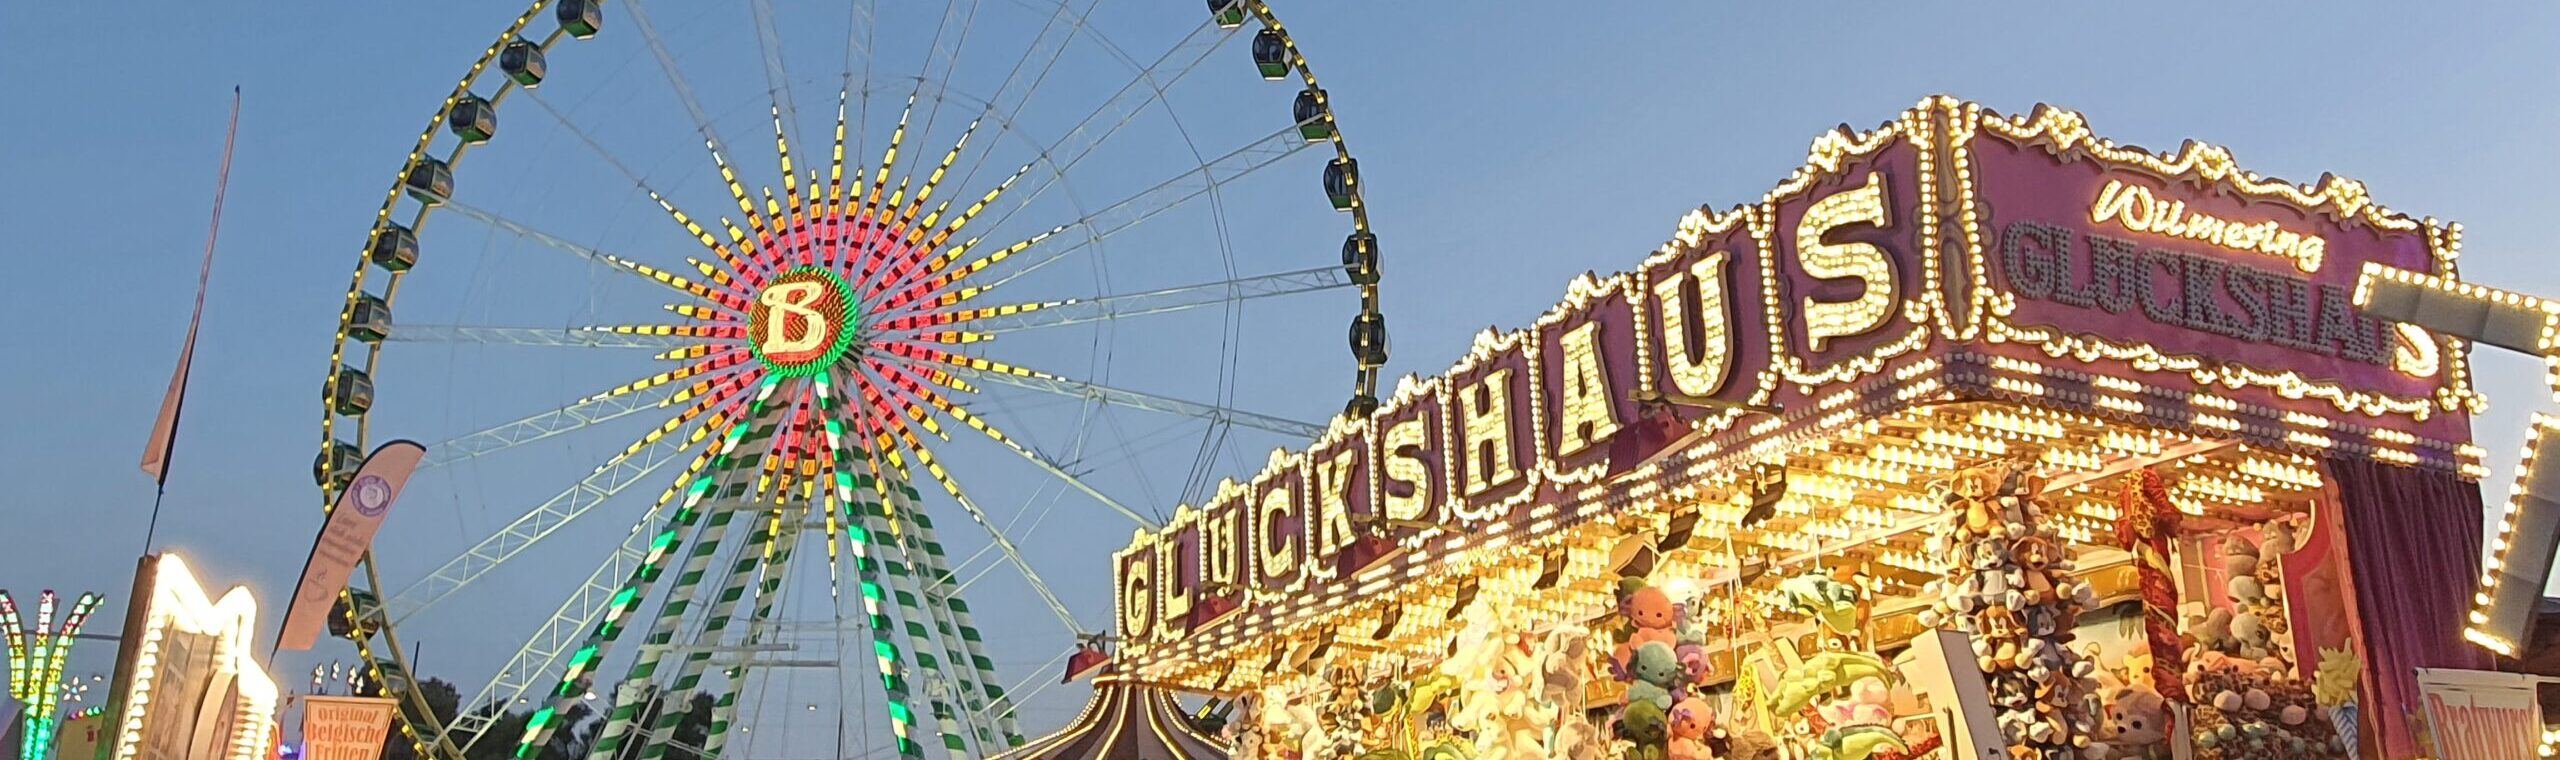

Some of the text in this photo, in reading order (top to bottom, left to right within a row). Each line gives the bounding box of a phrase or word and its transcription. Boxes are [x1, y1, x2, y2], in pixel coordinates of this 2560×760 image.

[2090, 179, 2325, 273] Wilmering
[761, 281, 827, 354] B
[307, 721, 384, 744] Belgische
[318, 706, 379, 724] Original
